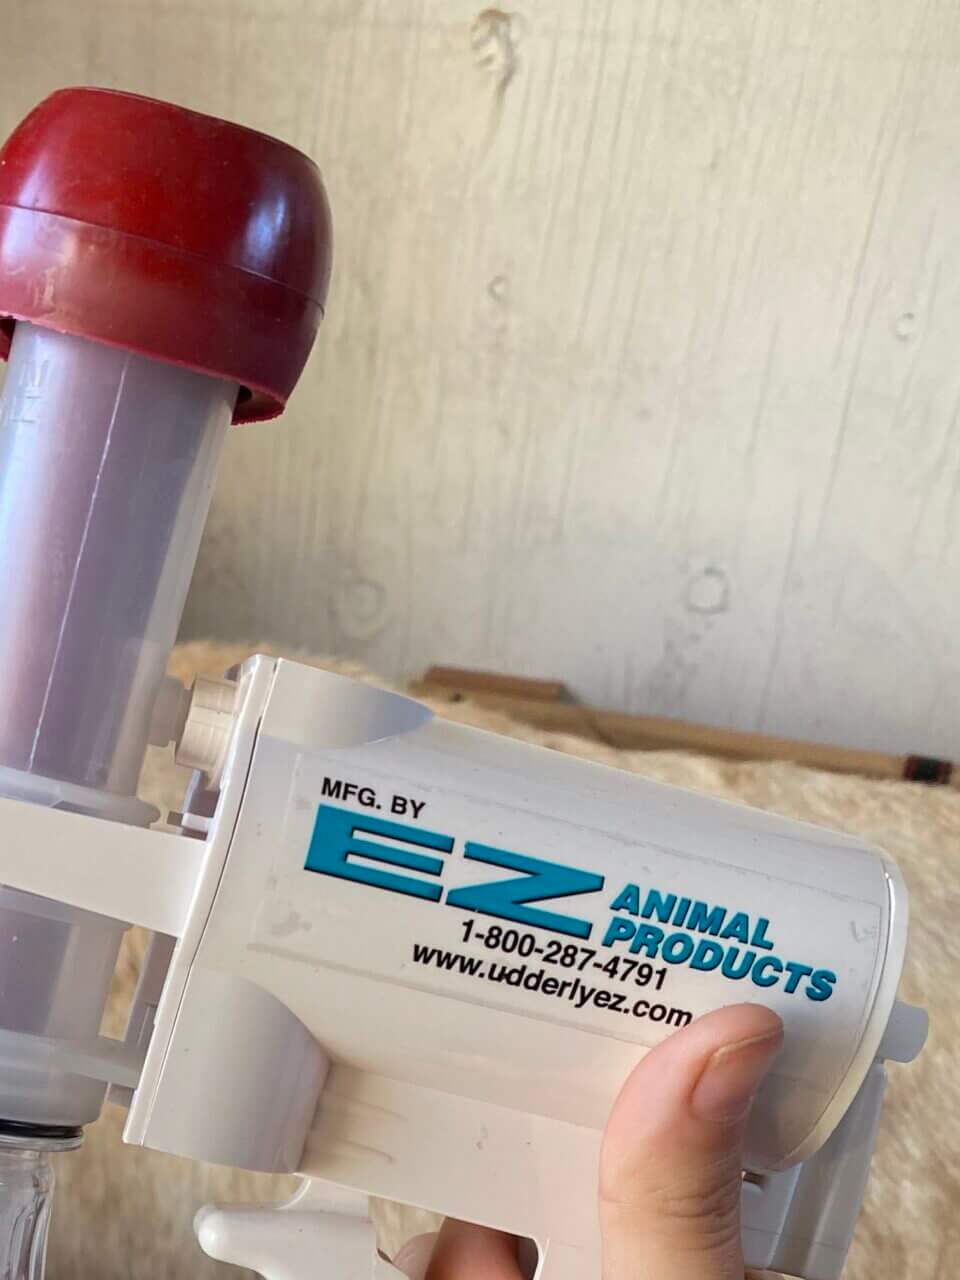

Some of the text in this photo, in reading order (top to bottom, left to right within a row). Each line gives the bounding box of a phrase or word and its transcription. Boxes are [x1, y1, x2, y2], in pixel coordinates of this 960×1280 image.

[321, 776, 427, 819] MFG. BY
[303, 803, 606, 940] EZ
[461, 919, 668, 991] 1-800-287-4791
[610, 883, 776, 951] ANIMAL
[412, 943, 693, 1028] www.udderlyez.com
[602, 917, 837, 1002] PRODUCTS
